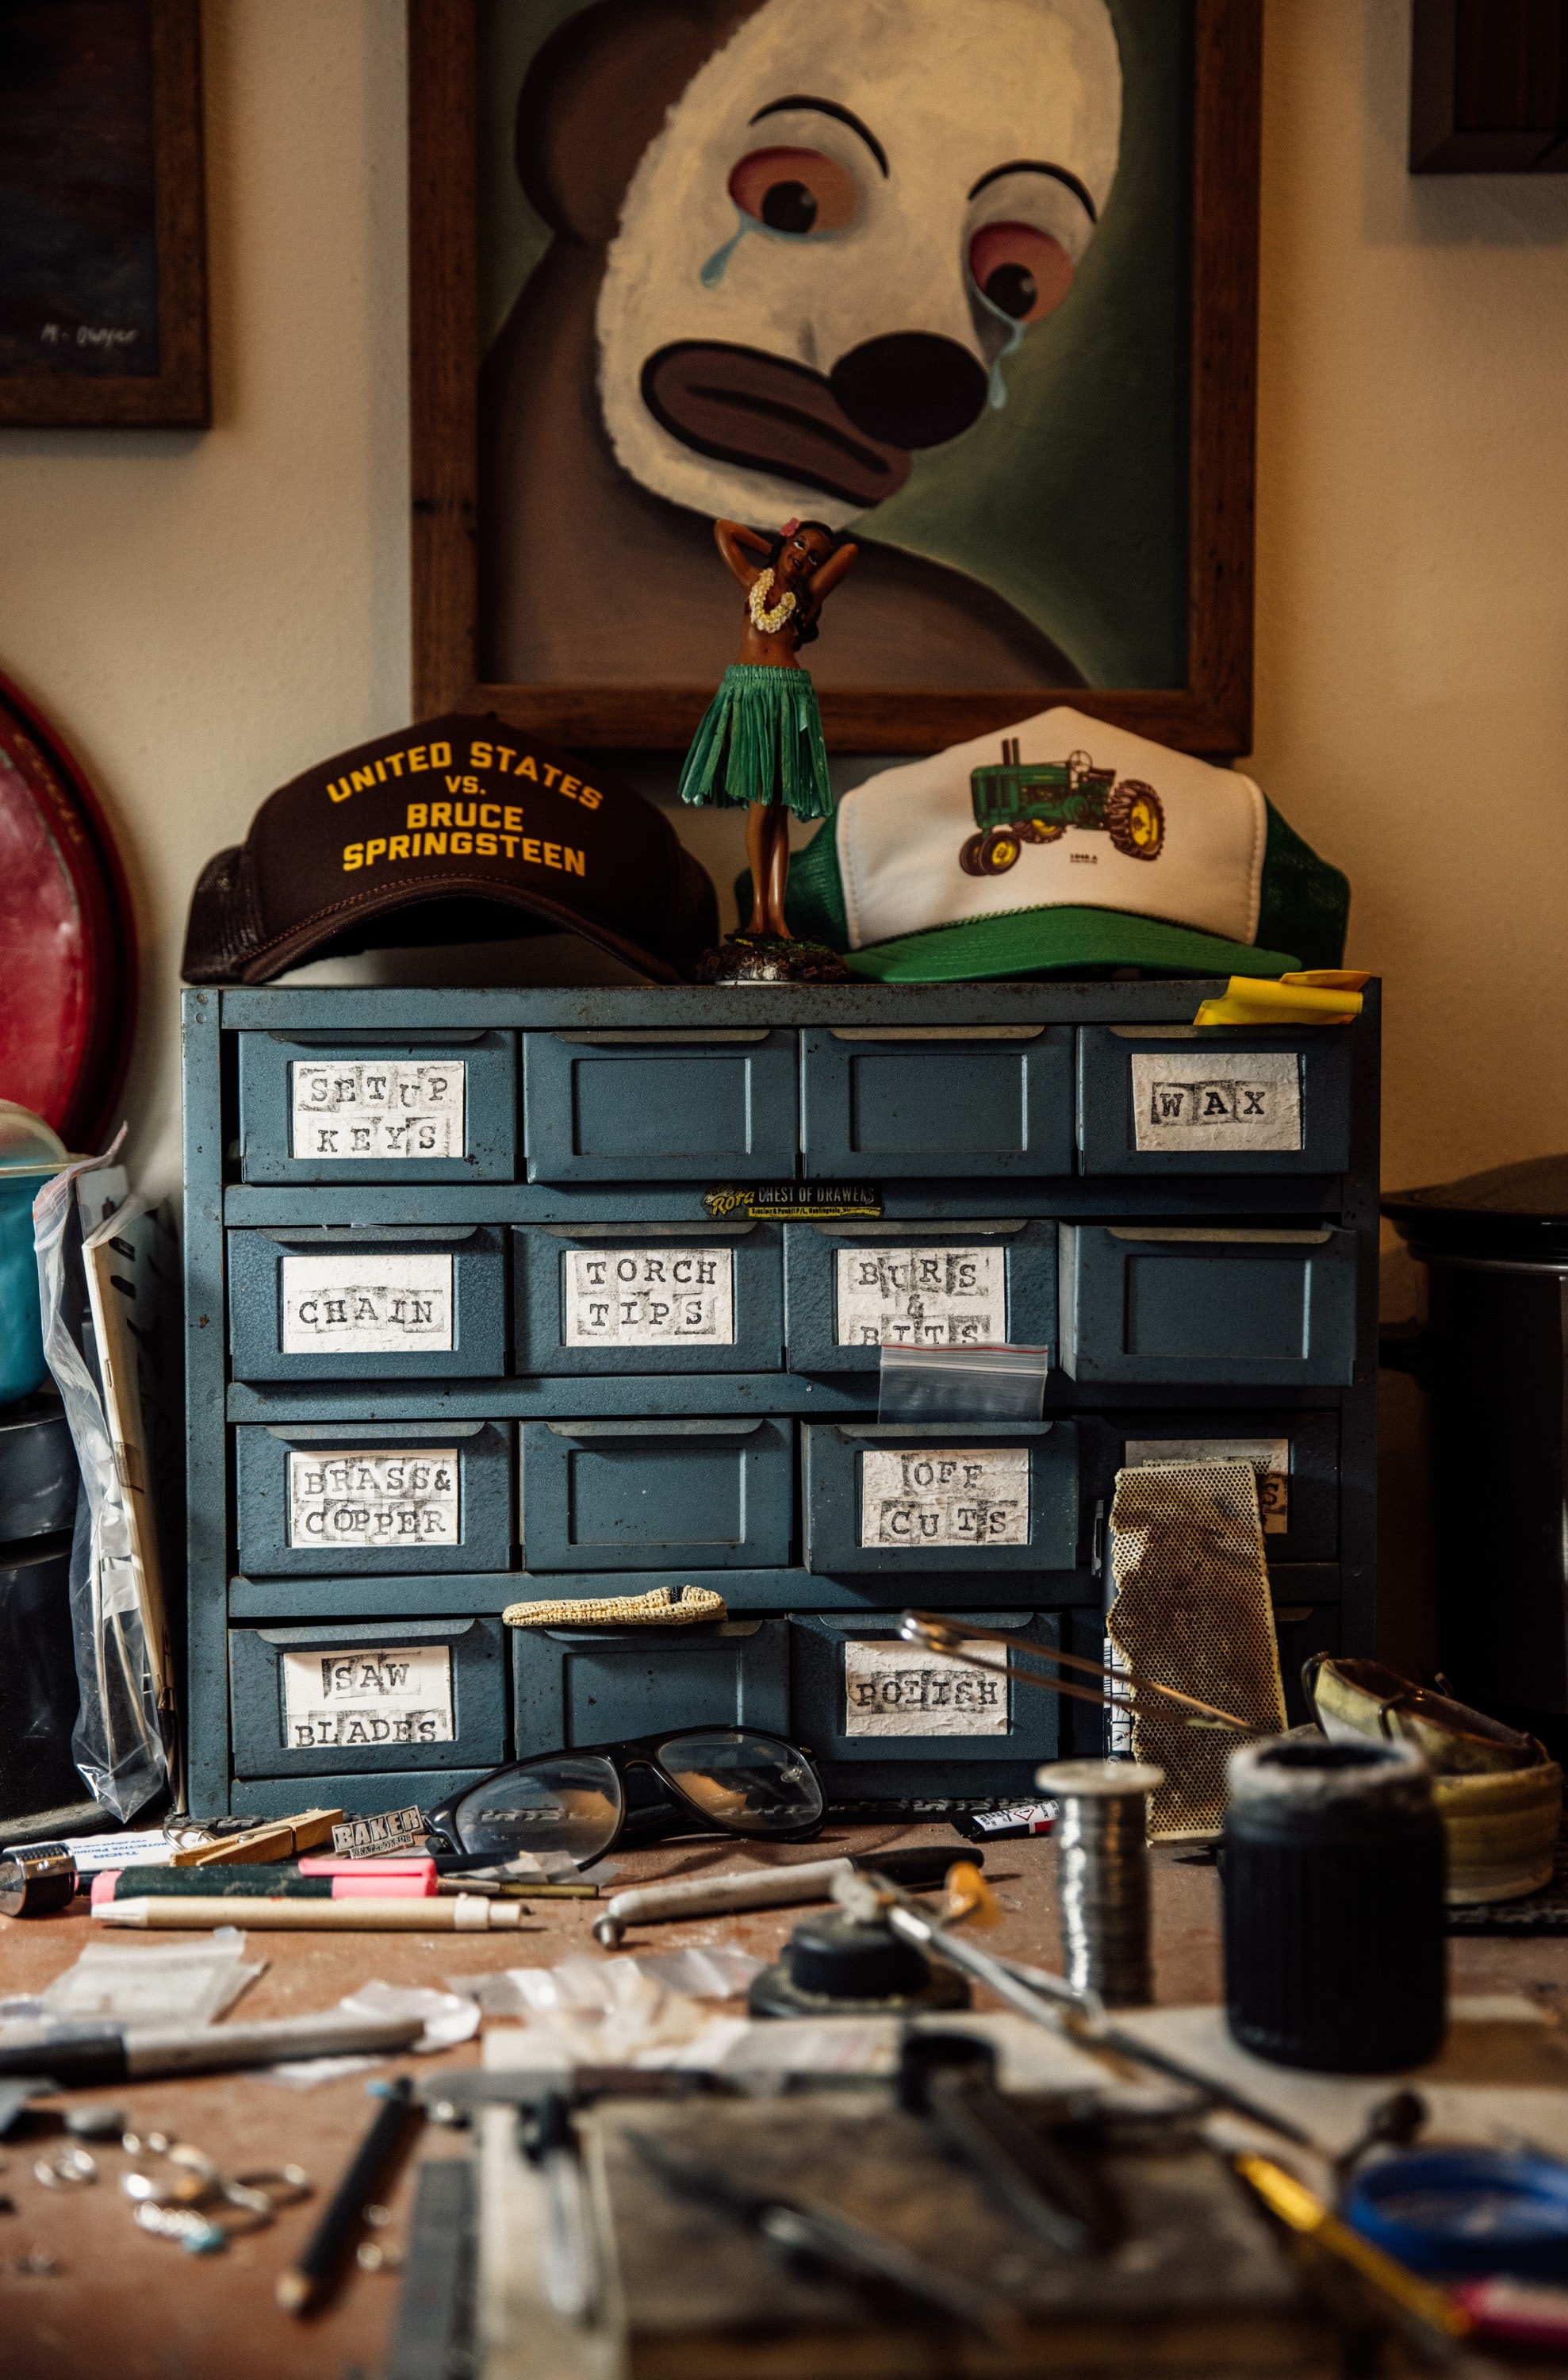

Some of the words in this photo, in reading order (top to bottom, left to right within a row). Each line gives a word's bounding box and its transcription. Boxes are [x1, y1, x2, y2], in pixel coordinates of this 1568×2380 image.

[326, 742, 452, 804] UNITED
[470, 741, 603, 811] STATES
[445, 776, 486, 795] VS.
[406, 803, 523, 832] BRUCE
[343, 832, 585, 877] SPRINGSTEEN
[1160, 1091, 1266, 1117] WAX
[317, 1126, 436, 1152] KEYS
[758, 1187, 793, 1203] CHEST
[799, 1187, 812, 1203] OF
[817, 1187, 874, 1203] DRAWERS
[586, 1258, 717, 1284] TORCH
[858, 1259, 976, 1288] BURS
[299, 1297, 433, 1324] CHAIN
[589, 1300, 702, 1326] TIPS
[914, 1461, 983, 1488] OFF
[305, 1509, 446, 1536] COPPER
[891, 1508, 1006, 1537] CUTS
[335, 1664, 409, 1691] SAW
[857, 1680, 999, 1706] POLISH
[295, 1719, 436, 1747] BLADES
[335, 1808, 420, 1850] BAKER
[112, 1841, 170, 1851] ROTECTIVE
[352, 1834, 412, 1856] SKATEBOARDS
